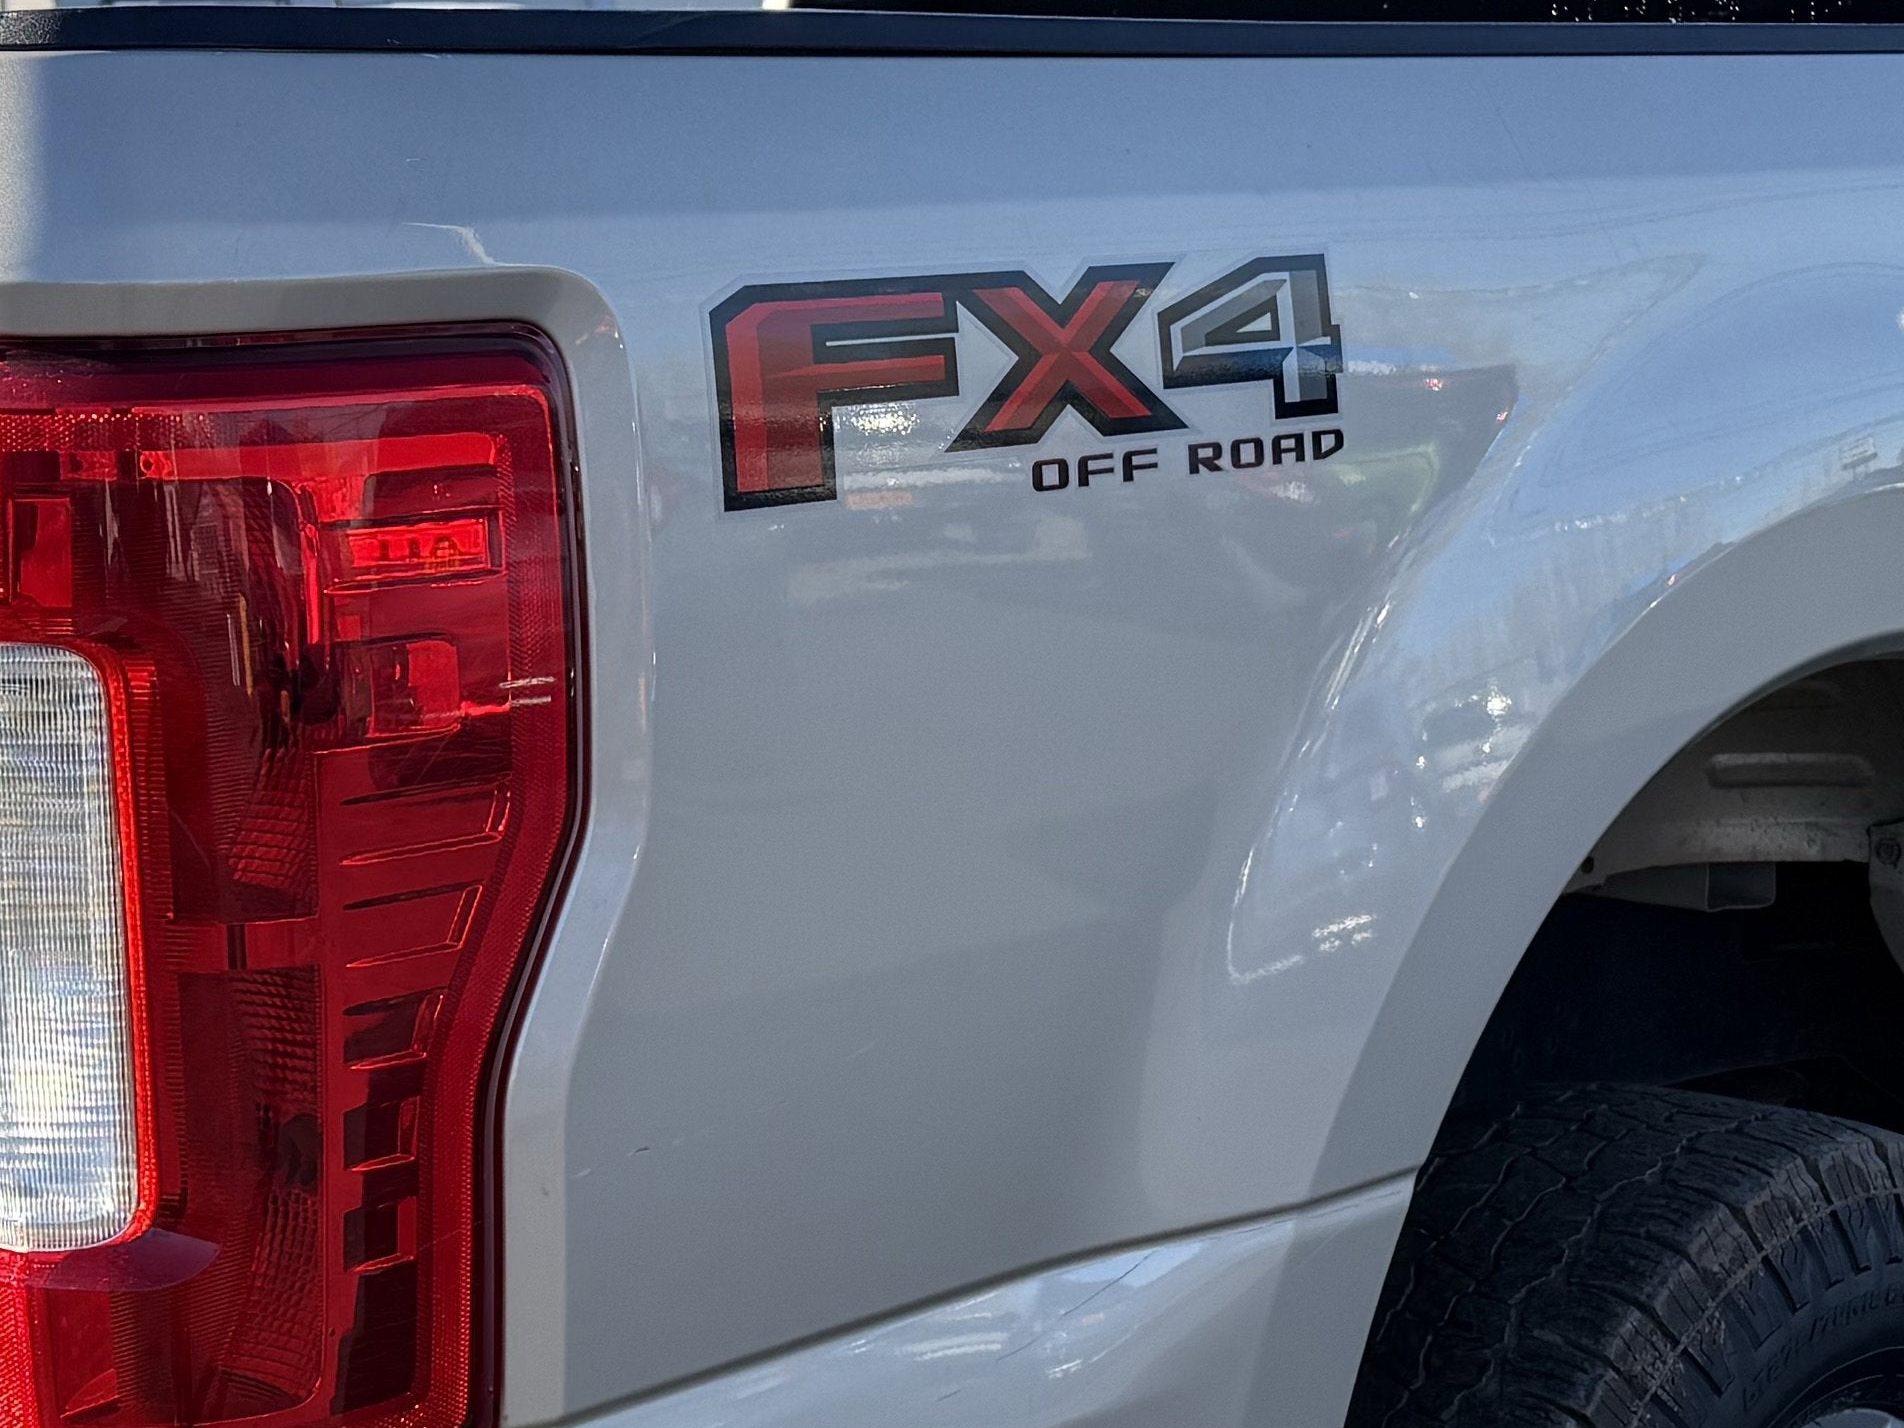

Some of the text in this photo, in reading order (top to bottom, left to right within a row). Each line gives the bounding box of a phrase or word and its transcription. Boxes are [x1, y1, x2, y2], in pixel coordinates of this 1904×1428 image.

[709, 253, 1341, 512] FX4
[1032, 429, 1345, 493] OFF ROAD
